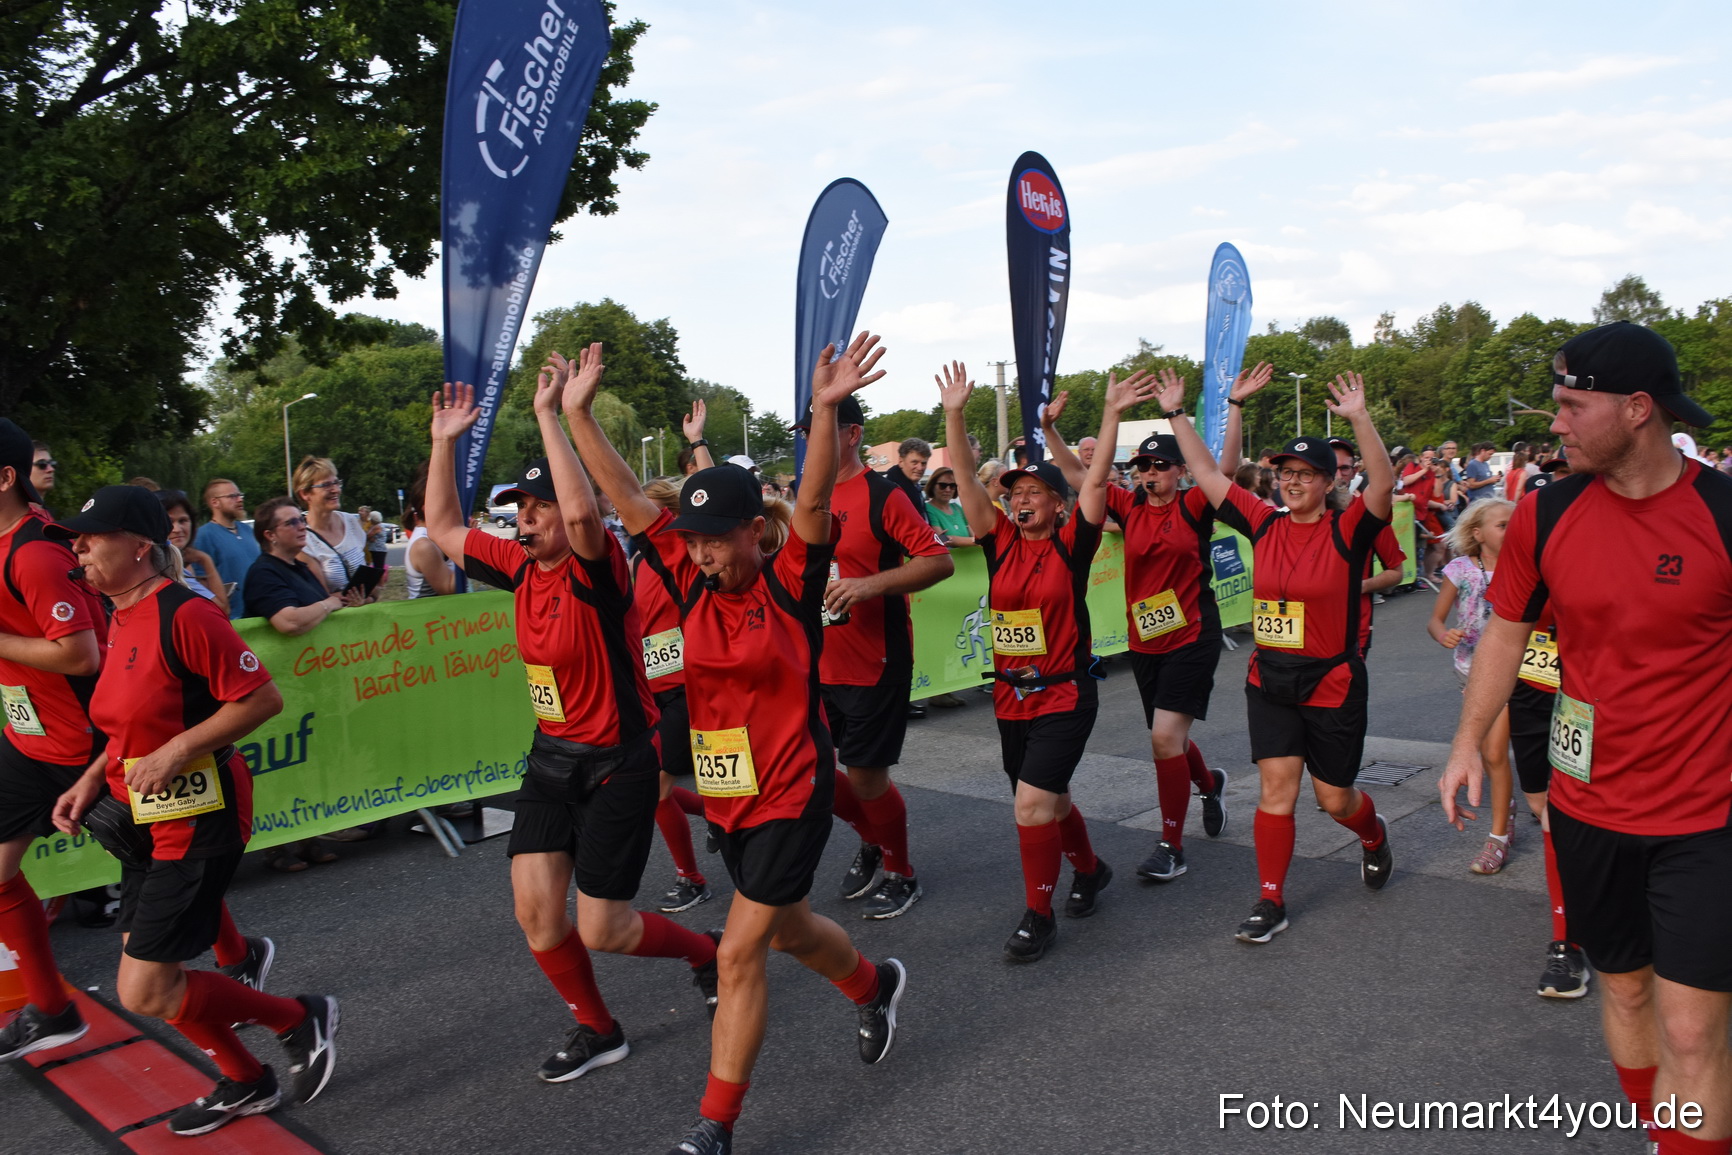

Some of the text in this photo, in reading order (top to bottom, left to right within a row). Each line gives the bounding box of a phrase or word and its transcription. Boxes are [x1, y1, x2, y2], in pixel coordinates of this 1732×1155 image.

[499, 0, 566, 149] Fischer
[532, 19, 580, 145] AUTOMOBILE
[1020, 179, 1063, 220] Hervis
[828, 209, 861, 286] Fischer
[465, 246, 537, 489] www.fischer-automobile.de
[1656, 553, 1684, 576] 23
[552, 597, 561, 613] 7
[747, 606, 765, 626] 24
[1139, 605, 1175, 630] 2339
[995, 626, 1036, 644] 2358
[1257, 616, 1293, 635] 2331
[128, 646, 138, 663] 3
[294, 610, 511, 677] Gesunde Firmen
[644, 644, 681, 668] 2365
[353, 665, 437, 702] laufen
[697, 754, 739, 779] 2357
[156, 798, 196, 810] Beyer Gaby
[250, 751, 529, 836] www.firmenlauf-oberpfalz.d
